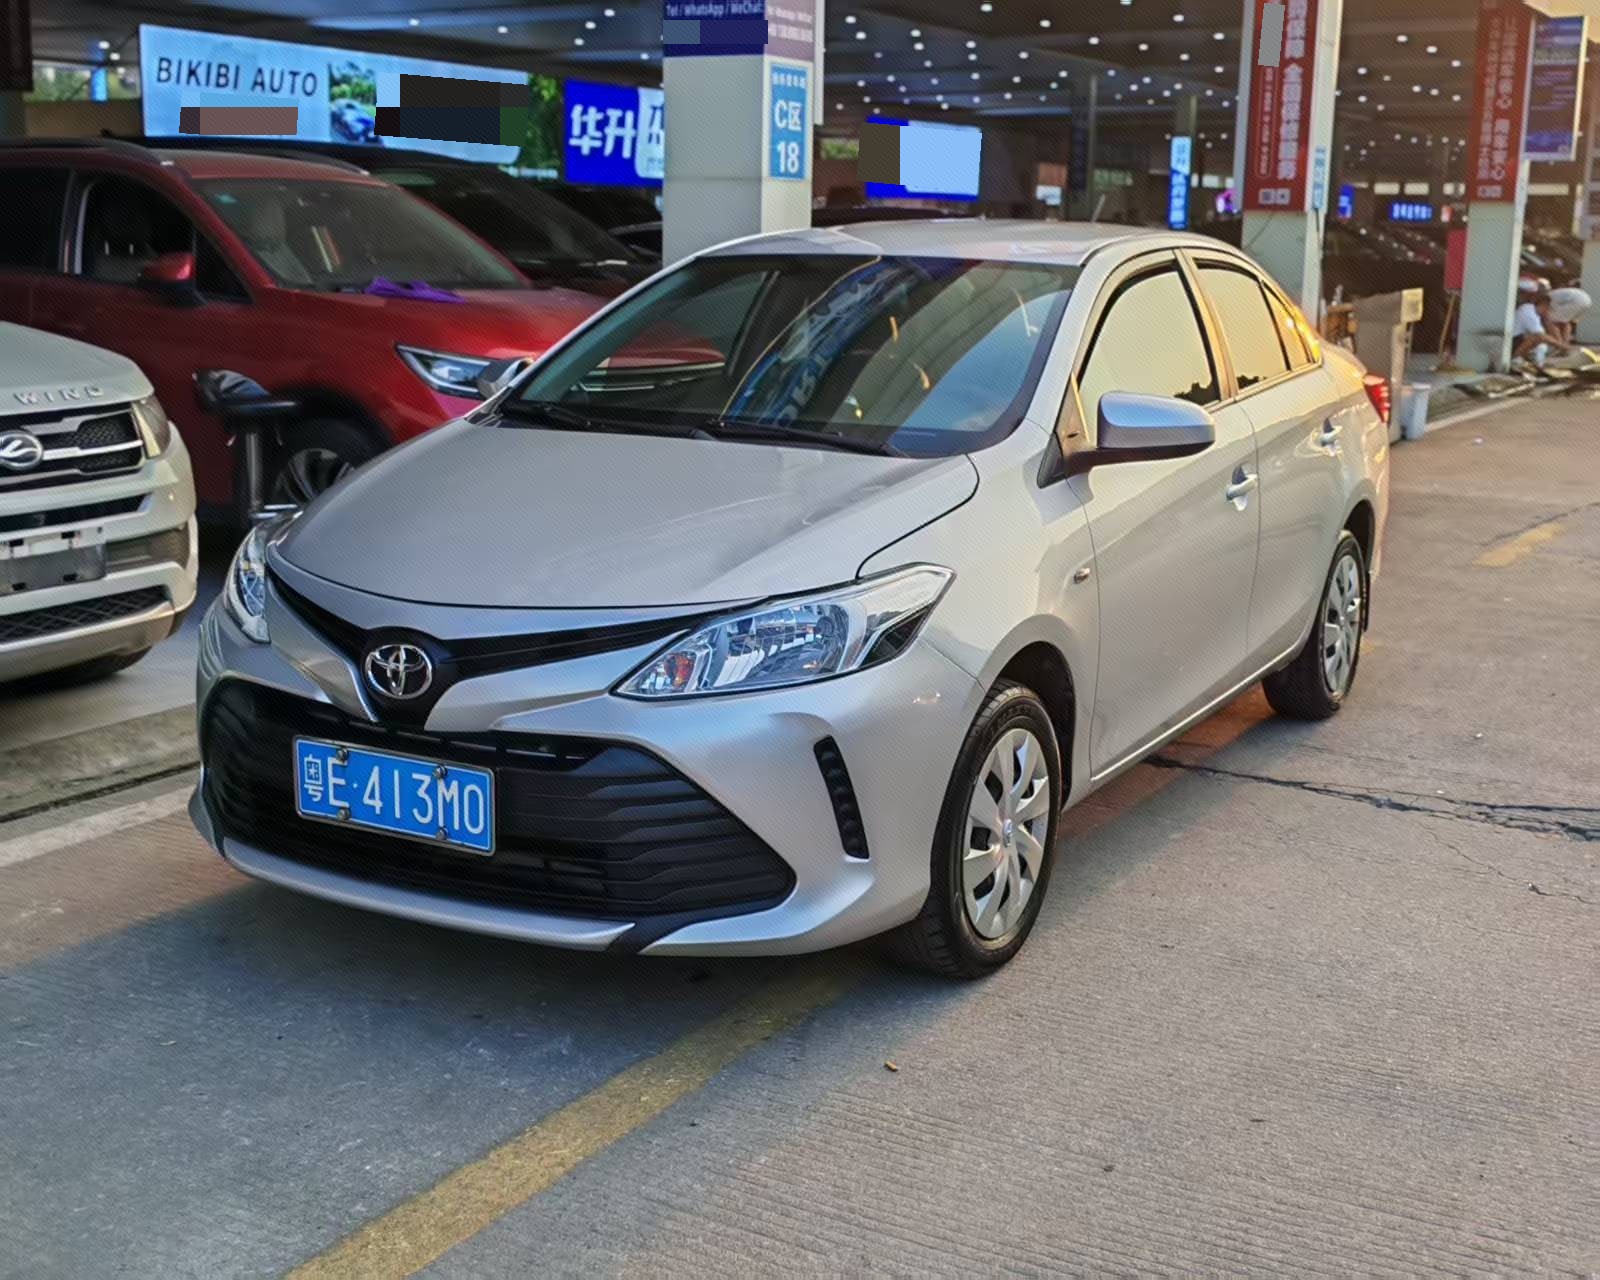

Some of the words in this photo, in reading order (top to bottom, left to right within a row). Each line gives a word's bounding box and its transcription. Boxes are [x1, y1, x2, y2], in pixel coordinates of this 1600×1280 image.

[157, 56, 240, 91] BIKIBI
[251, 67, 318, 96] AUTO
[568, 104, 637, 159] 华升
[774, 100, 802, 131] C区
[775, 141, 800, 174] 18
